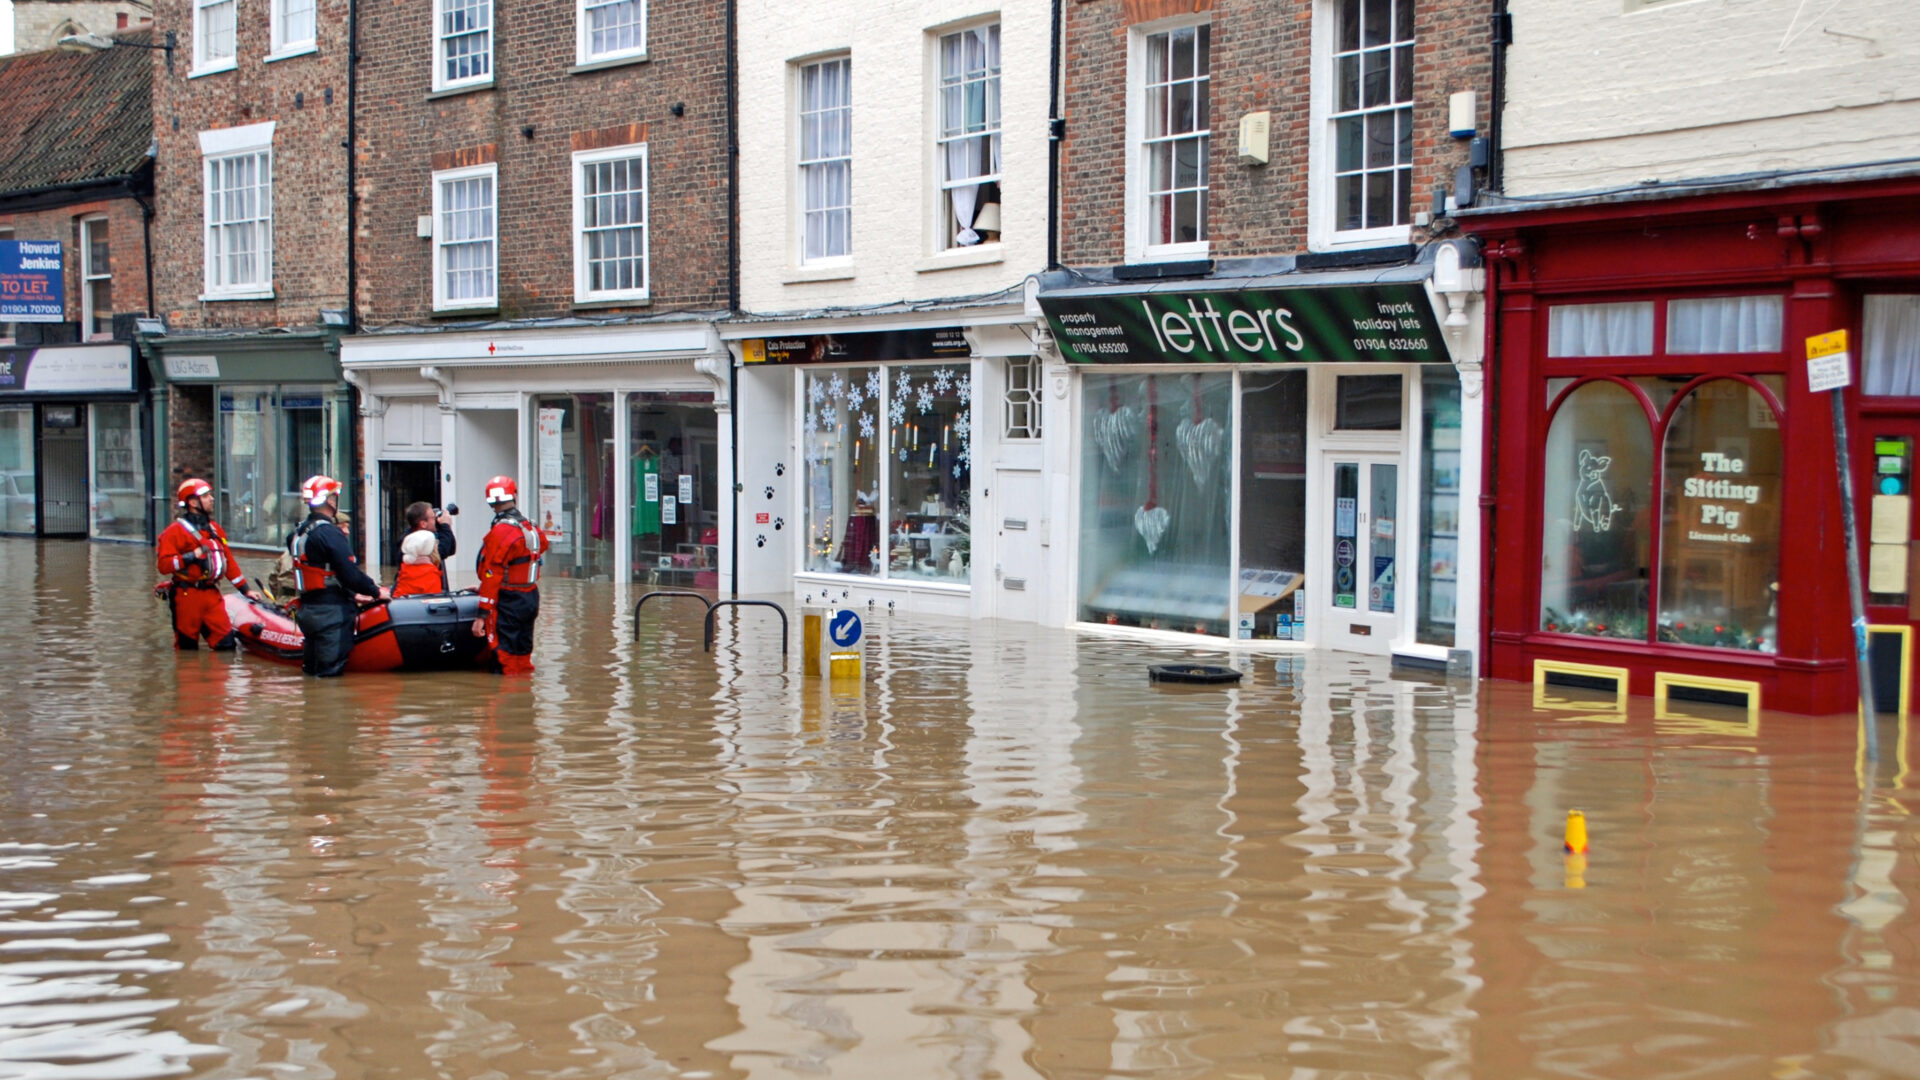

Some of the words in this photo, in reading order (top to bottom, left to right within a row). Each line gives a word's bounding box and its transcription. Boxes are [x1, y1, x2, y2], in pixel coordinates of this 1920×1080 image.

[20, 242, 60, 254] Howard
[20, 257, 60, 269] Jenkins
[2, 281, 20, 293] TO
[24, 281, 49, 293] LET
[2, 304, 27, 313] 01904
[30, 304, 61, 313] 707000
[1377, 302, 1414, 315] inyork
[1060, 312, 1096, 324] property
[1142, 298, 1304, 353] letters
[1353, 319, 1397, 332] holiday
[1399, 318, 1421, 329] lets
[1066, 325, 1123, 338] management
[1072, 343, 1097, 353] 01904
[1099, 343, 1129, 353] 655200
[1353, 338, 1386, 350] 01904
[1389, 338, 1428, 350] 632660
[1701, 453, 1743, 473] The
[1684, 478, 1759, 504] Sitting
[1701, 505, 1740, 529] Pig
